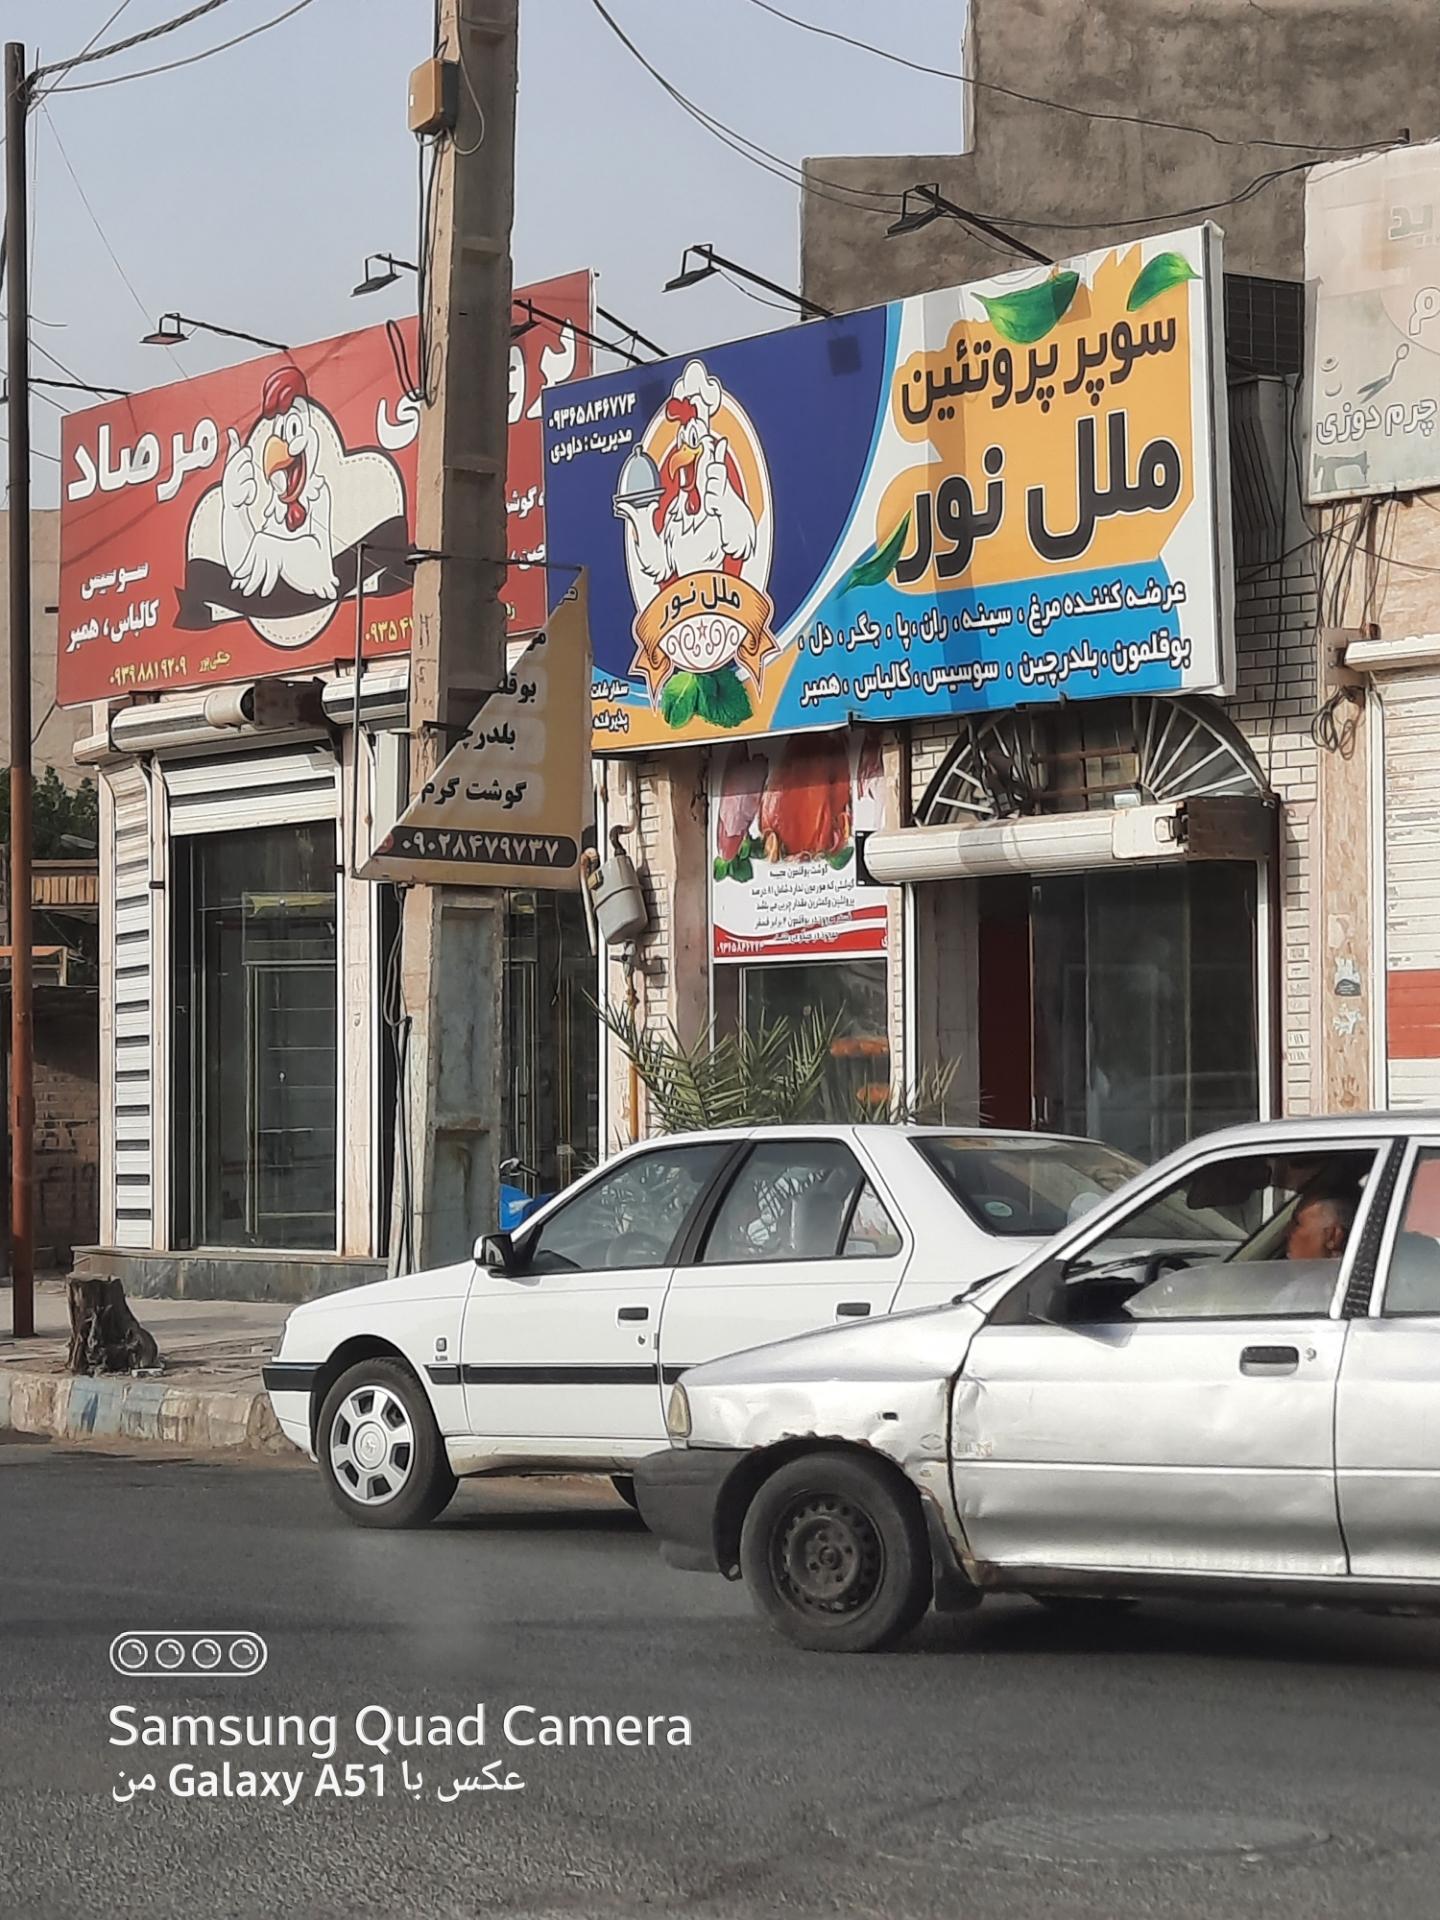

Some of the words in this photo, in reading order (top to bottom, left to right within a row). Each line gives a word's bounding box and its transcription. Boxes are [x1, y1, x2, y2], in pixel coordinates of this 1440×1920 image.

[1063, 317, 1177, 407] سوپر
[901, 338, 1059, 425] پروتئین
[1316, 402, 1382, 446] دوزی
[1385, 399, 1438, 437] چرم
[67, 417, 218, 503] مرصاد
[550, 435, 583, 464] داودی
[1026, 408, 1182, 562] ملل
[895, 445, 1005, 584] نور
[81, 562, 149, 600] سوسیس
[701, 575, 740, 609] ملل
[1064, 579, 1121, 615] کننده
[1125, 577, 1186, 610] عرضه
[659, 581, 697, 629] نور
[66, 618, 99, 653] همبر
[800, 673, 840, 706] همبر
[420, 777, 461, 804] گرم
[466, 778, 528, 809] گوشت
[402, 831, 560, 864] ۰۹۰۲۸۴۷۹۷۳۷
